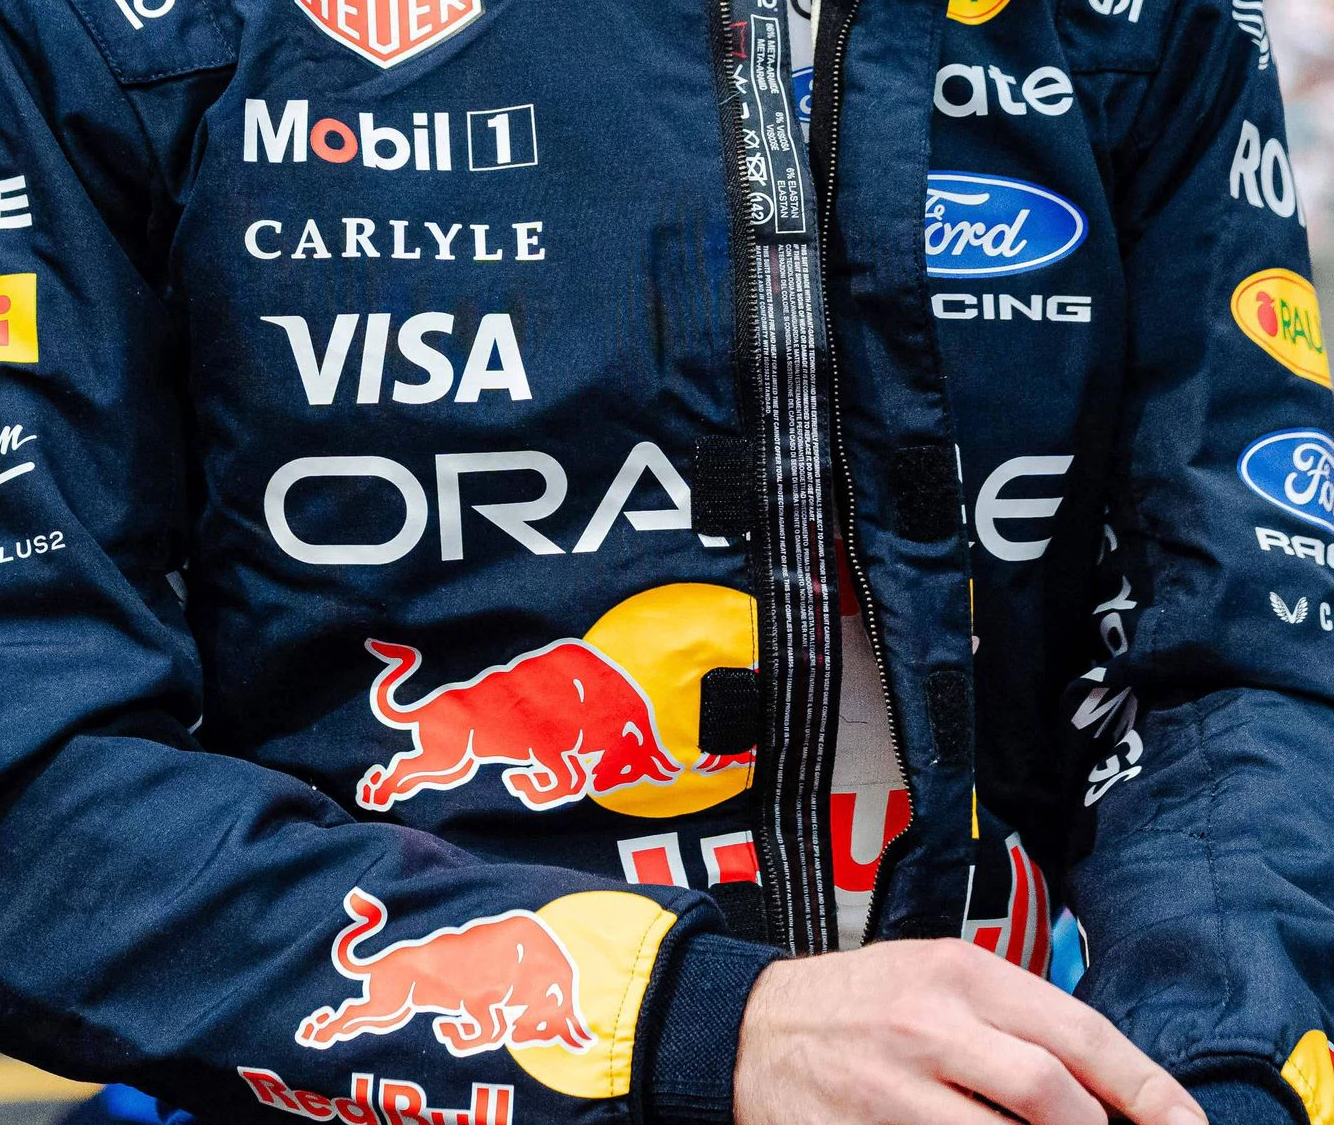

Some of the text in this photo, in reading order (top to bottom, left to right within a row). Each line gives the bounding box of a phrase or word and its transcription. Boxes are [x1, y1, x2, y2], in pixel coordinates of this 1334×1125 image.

[933, 62, 1074, 118] ate
[243, 98, 452, 171] Mobil
[776, 180, 788, 219] ELASTAN
[787, 180, 799, 219] ELASTAN
[1229, 119, 1307, 229] RO
[244, 216, 546, 261] CARLYLE
[259, 311, 533, 406] VISA
[236, 1065, 378, 1125] Red
